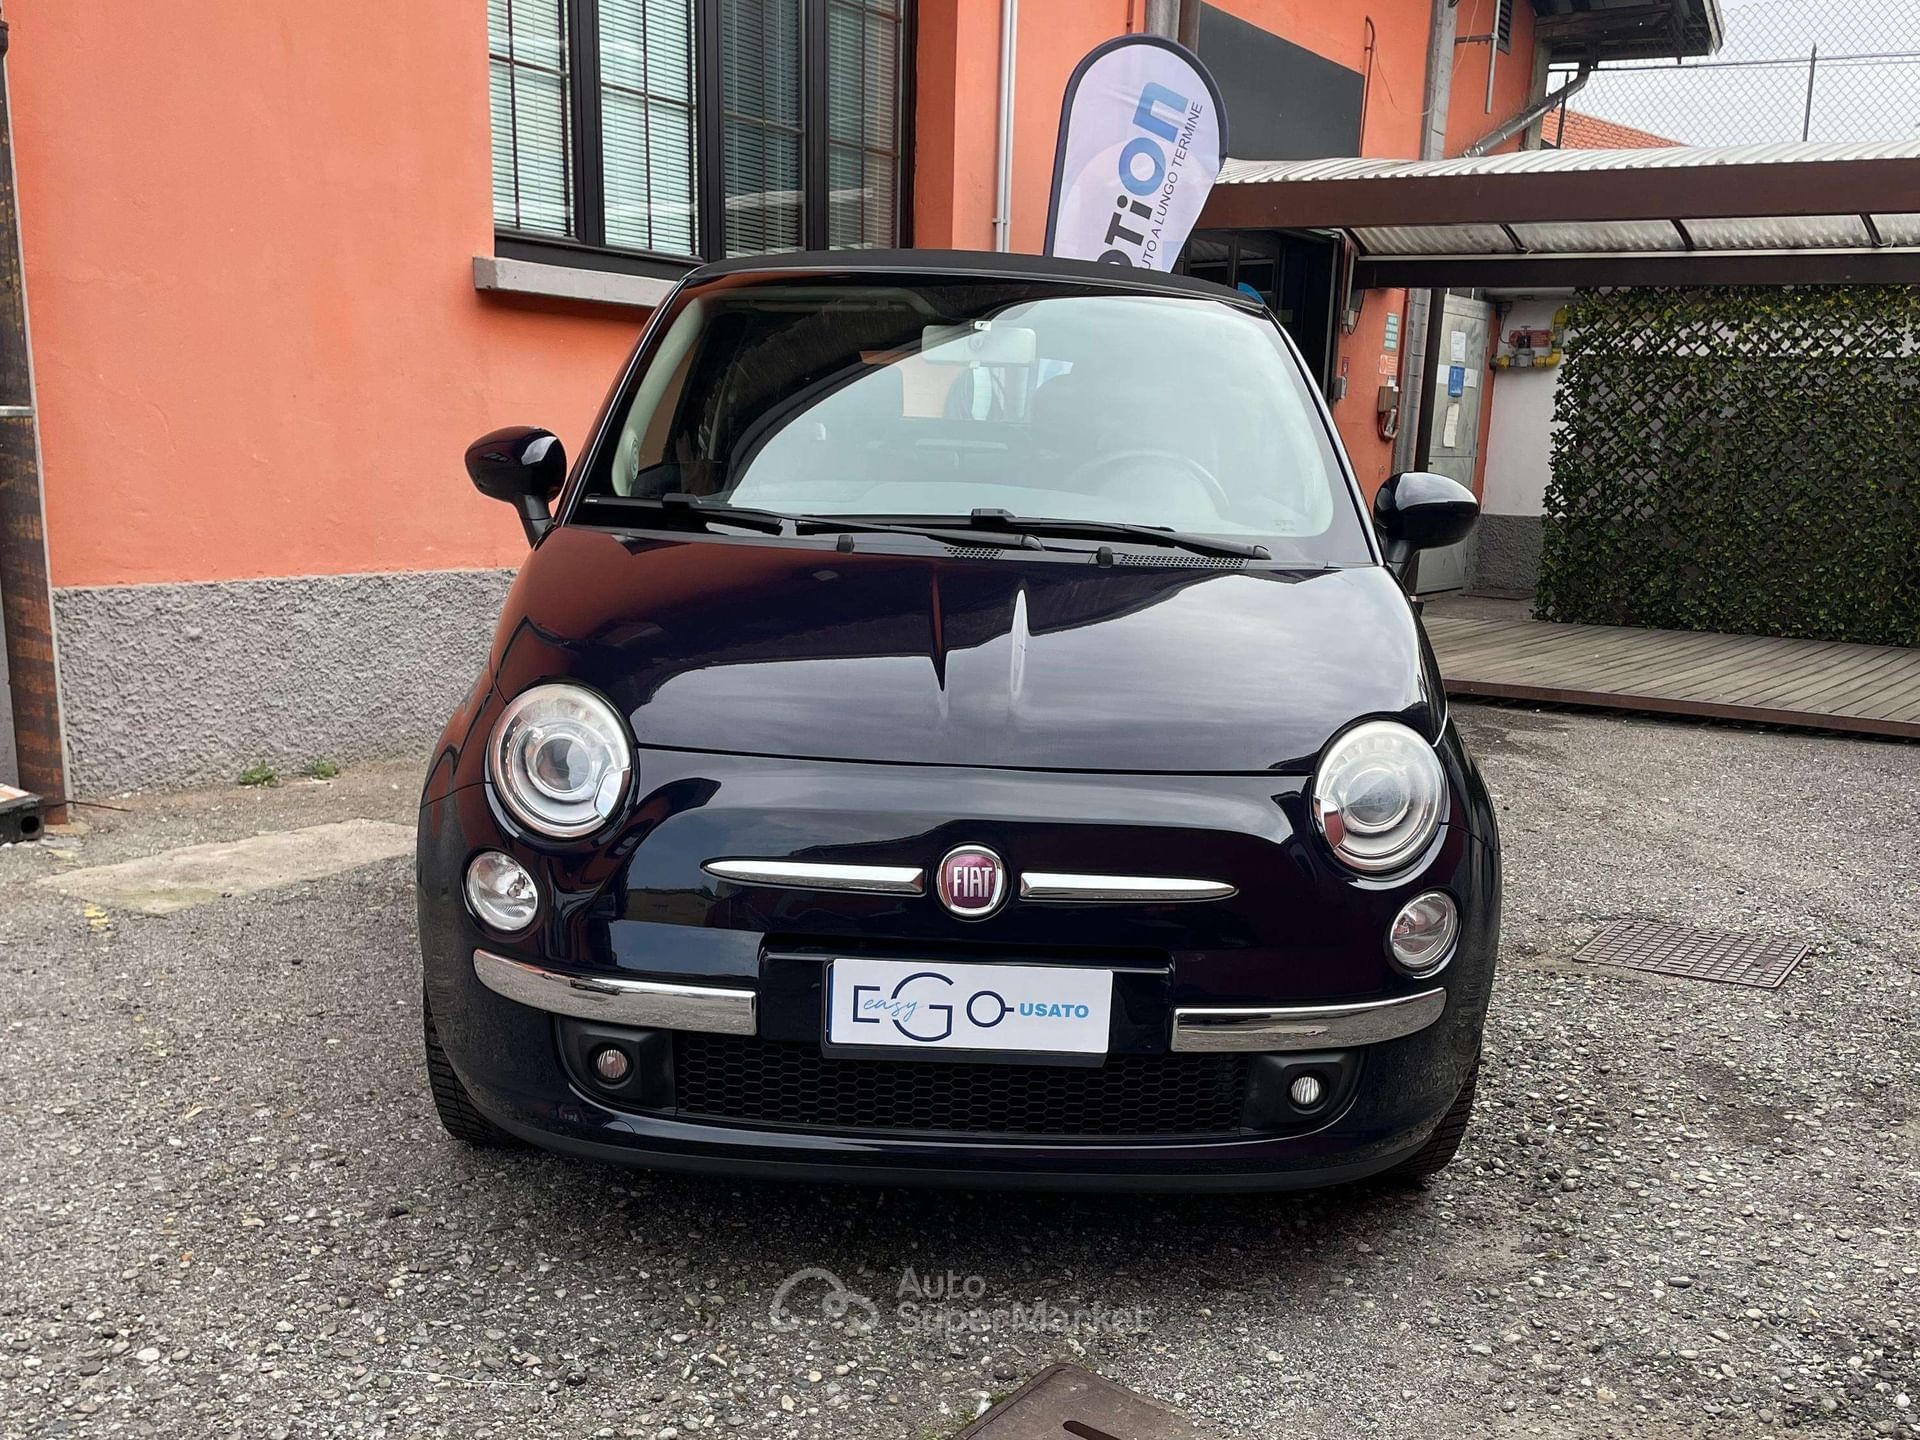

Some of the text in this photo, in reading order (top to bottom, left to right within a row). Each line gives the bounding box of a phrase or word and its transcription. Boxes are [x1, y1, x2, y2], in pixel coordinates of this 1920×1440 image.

[1171, 102, 1203, 168] TERMINE
[1153, 171, 1178, 226] LUNGO
[1151, 228, 1162, 240] A
[953, 866, 993, 897] FIAT
[863, 998, 918, 1022] easy
[1020, 1002, 1089, 1019] USATO
